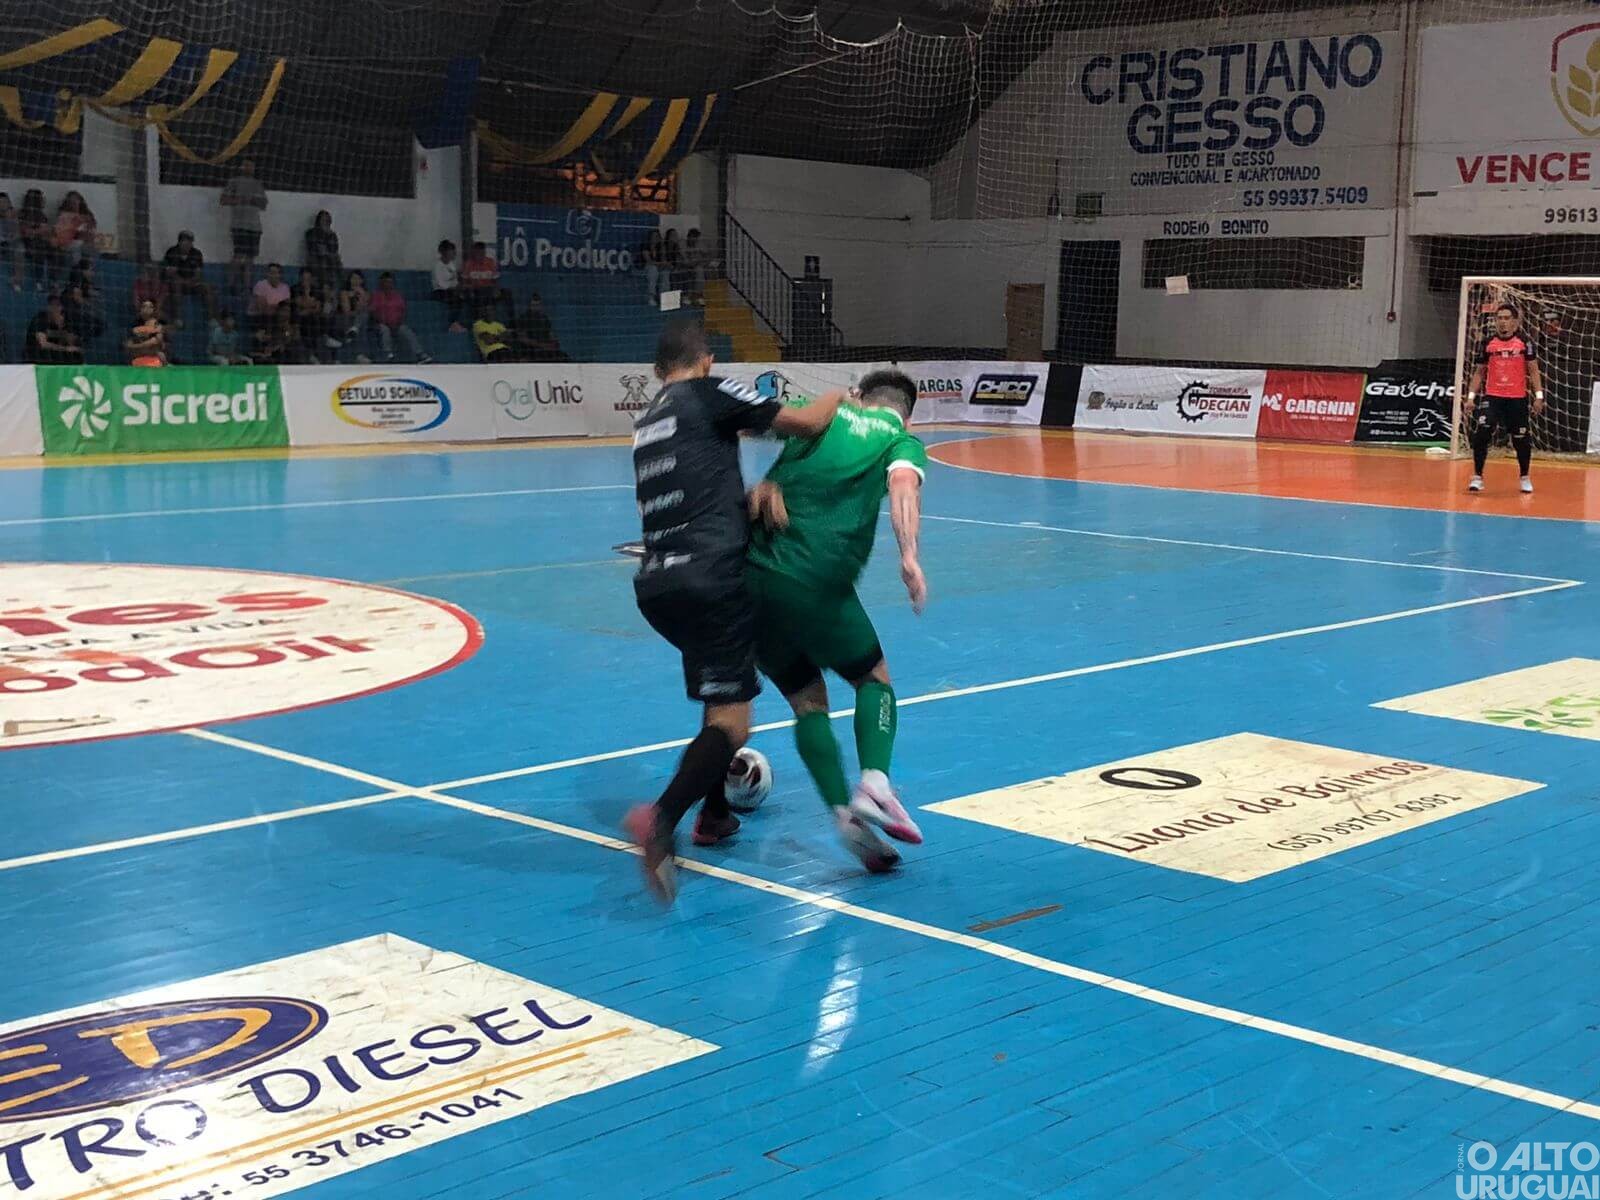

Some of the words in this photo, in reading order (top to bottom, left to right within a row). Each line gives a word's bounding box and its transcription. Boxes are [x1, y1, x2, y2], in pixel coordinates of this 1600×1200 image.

[1080, 34, 1383, 105] CRISTIANO
[1127, 94, 1325, 154] GESSO
[1166, 153, 1200, 168] TUDO
[1206, 152, 1226, 167] EM
[1232, 151, 1275, 167] GESSO
[1456, 152, 1591, 185] VENCE
[1130, 169, 1220, 186] CONVENCIONAL
[1224, 169, 1233, 182] E
[1237, 166, 1321, 183] ACARTONADO
[1243, 190, 1264, 207] 55
[1221, 219, 1269, 235] BONITO
[1544, 208, 1598, 223] 99613
[500, 227, 528, 267] JÔ
[338, 387, 386, 400] GETULIO
[916, 379, 962, 393] ARGAS
[122, 383, 269, 426] Sicredi
[1200, 399, 1250, 412] DECIAN
[1285, 398, 1355, 416] CARGNIN
[1084, 808, 1243, 854] Luana
[1226, 795, 1296, 816] de
[1278, 760, 1430, 800] Bairros
[1268, 833, 1334, 852] (55)
[1321, 809, 1402, 836] 99707
[236, 999, 593, 1114] DIESEL
[242, 1164, 291, 1186] 55
[292, 1087, 524, 1167] 3746-1041
